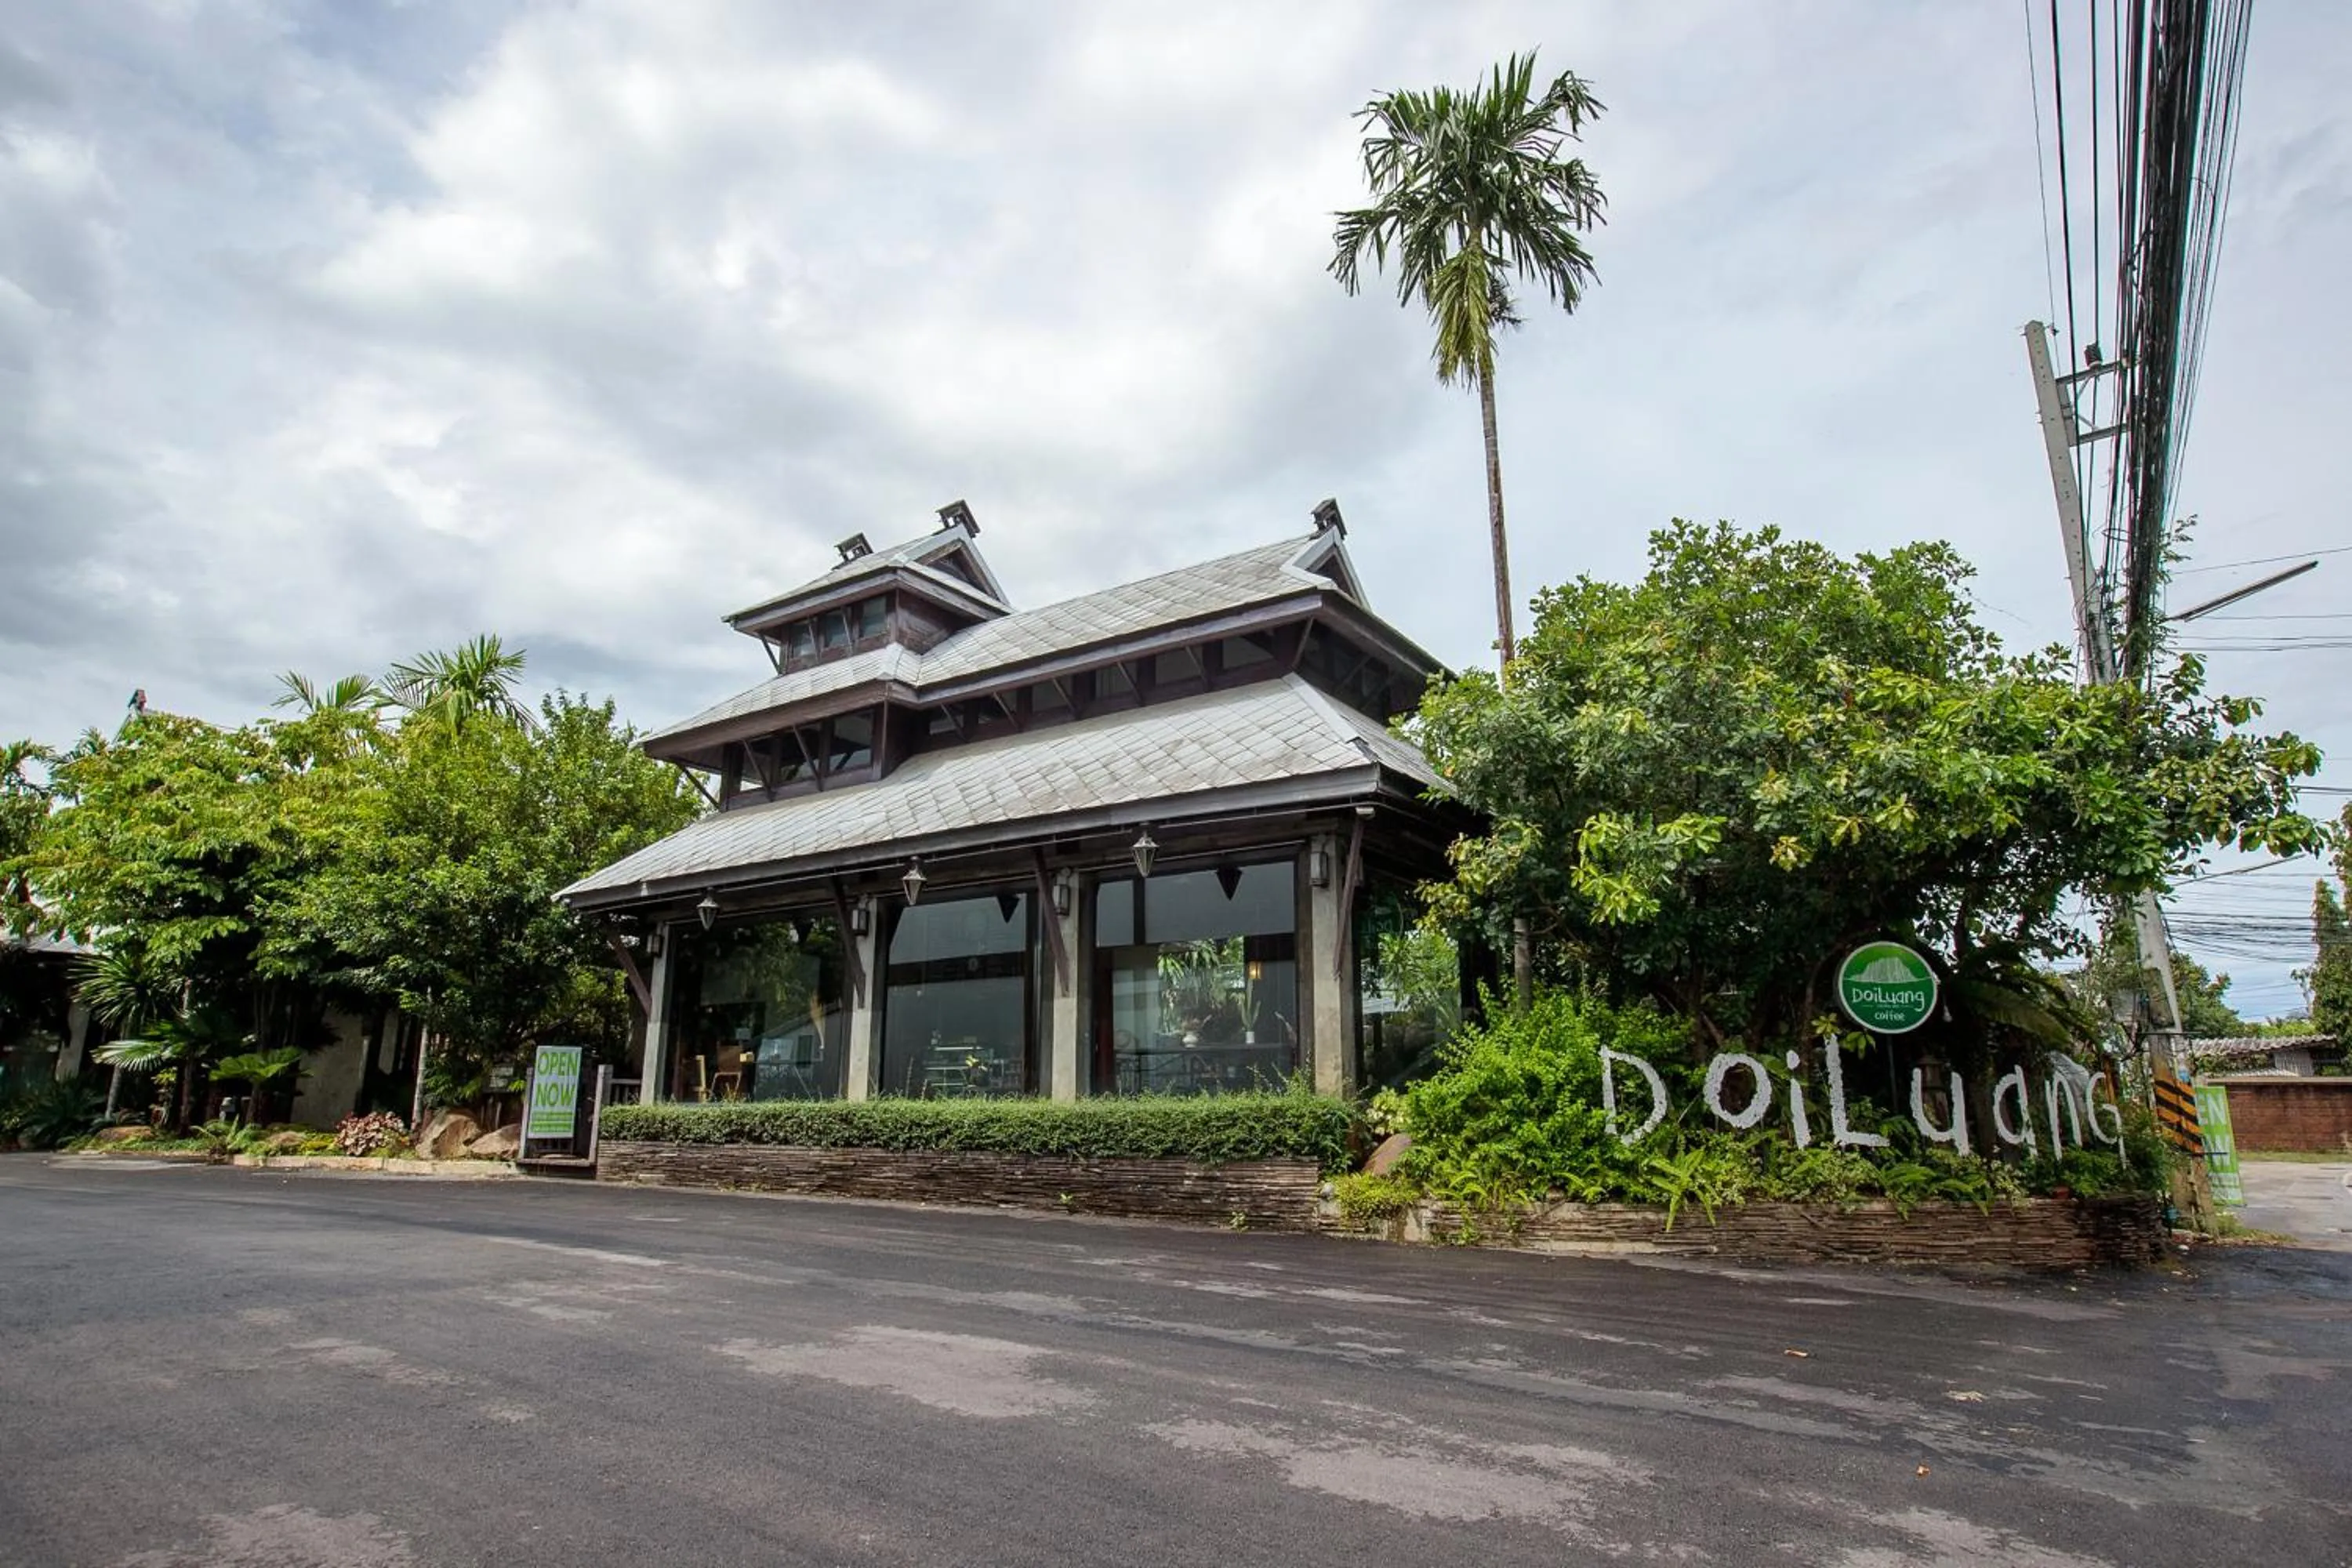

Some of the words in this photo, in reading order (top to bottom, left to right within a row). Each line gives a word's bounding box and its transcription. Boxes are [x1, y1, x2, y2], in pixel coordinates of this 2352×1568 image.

[1852, 987, 1925, 1011] DoiLuang
[1874, 1010, 1906, 1021] coffee
[537, 1051, 578, 1076] OPEN
[535, 1082, 575, 1106] NOW
